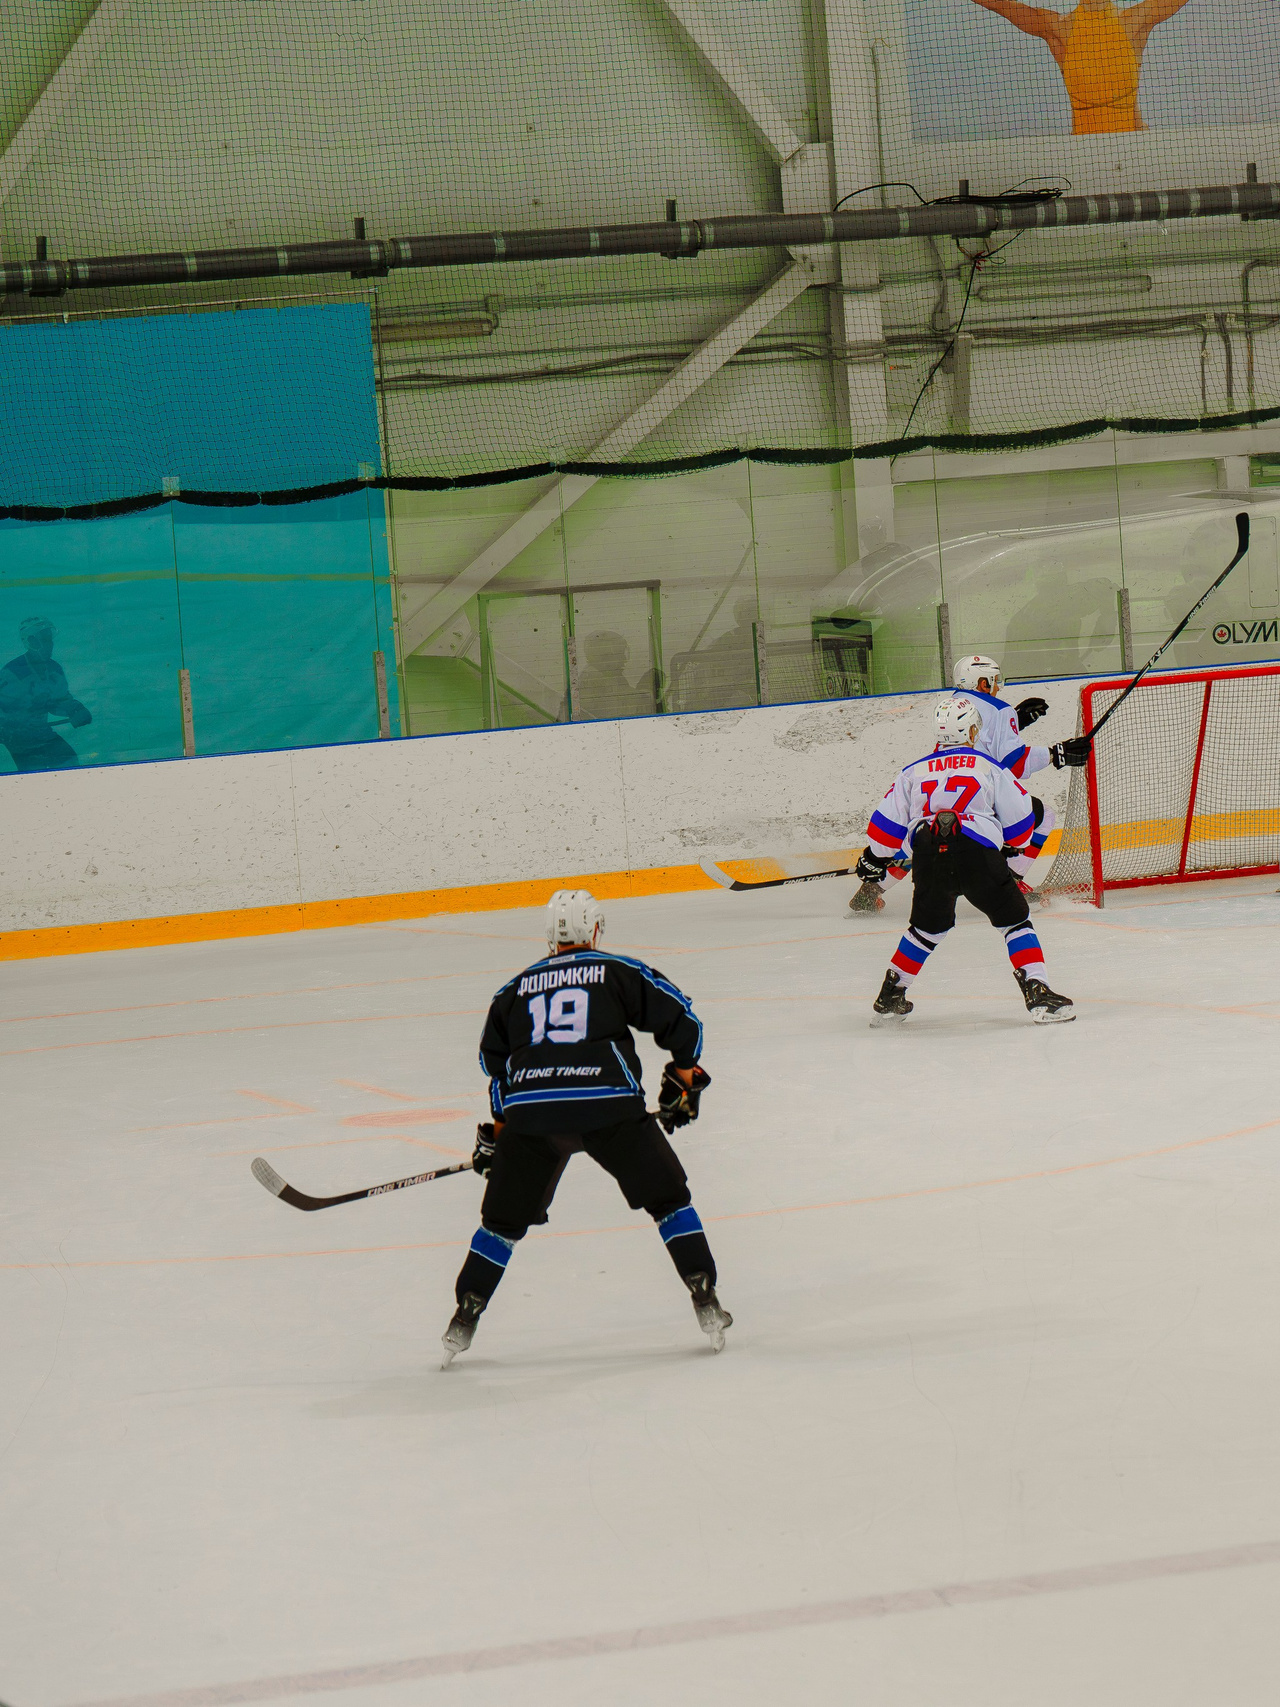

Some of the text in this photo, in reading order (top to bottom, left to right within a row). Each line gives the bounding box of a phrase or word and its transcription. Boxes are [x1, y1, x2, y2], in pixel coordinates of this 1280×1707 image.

[927, 755, 977, 773] ГАЛЕЕВ
[920, 775, 982, 818] 17
[528, 988, 590, 1045] 19
[525, 1066, 602, 1079] ONE TIMER
[367, 1171, 437, 1198] ONE TIMER
